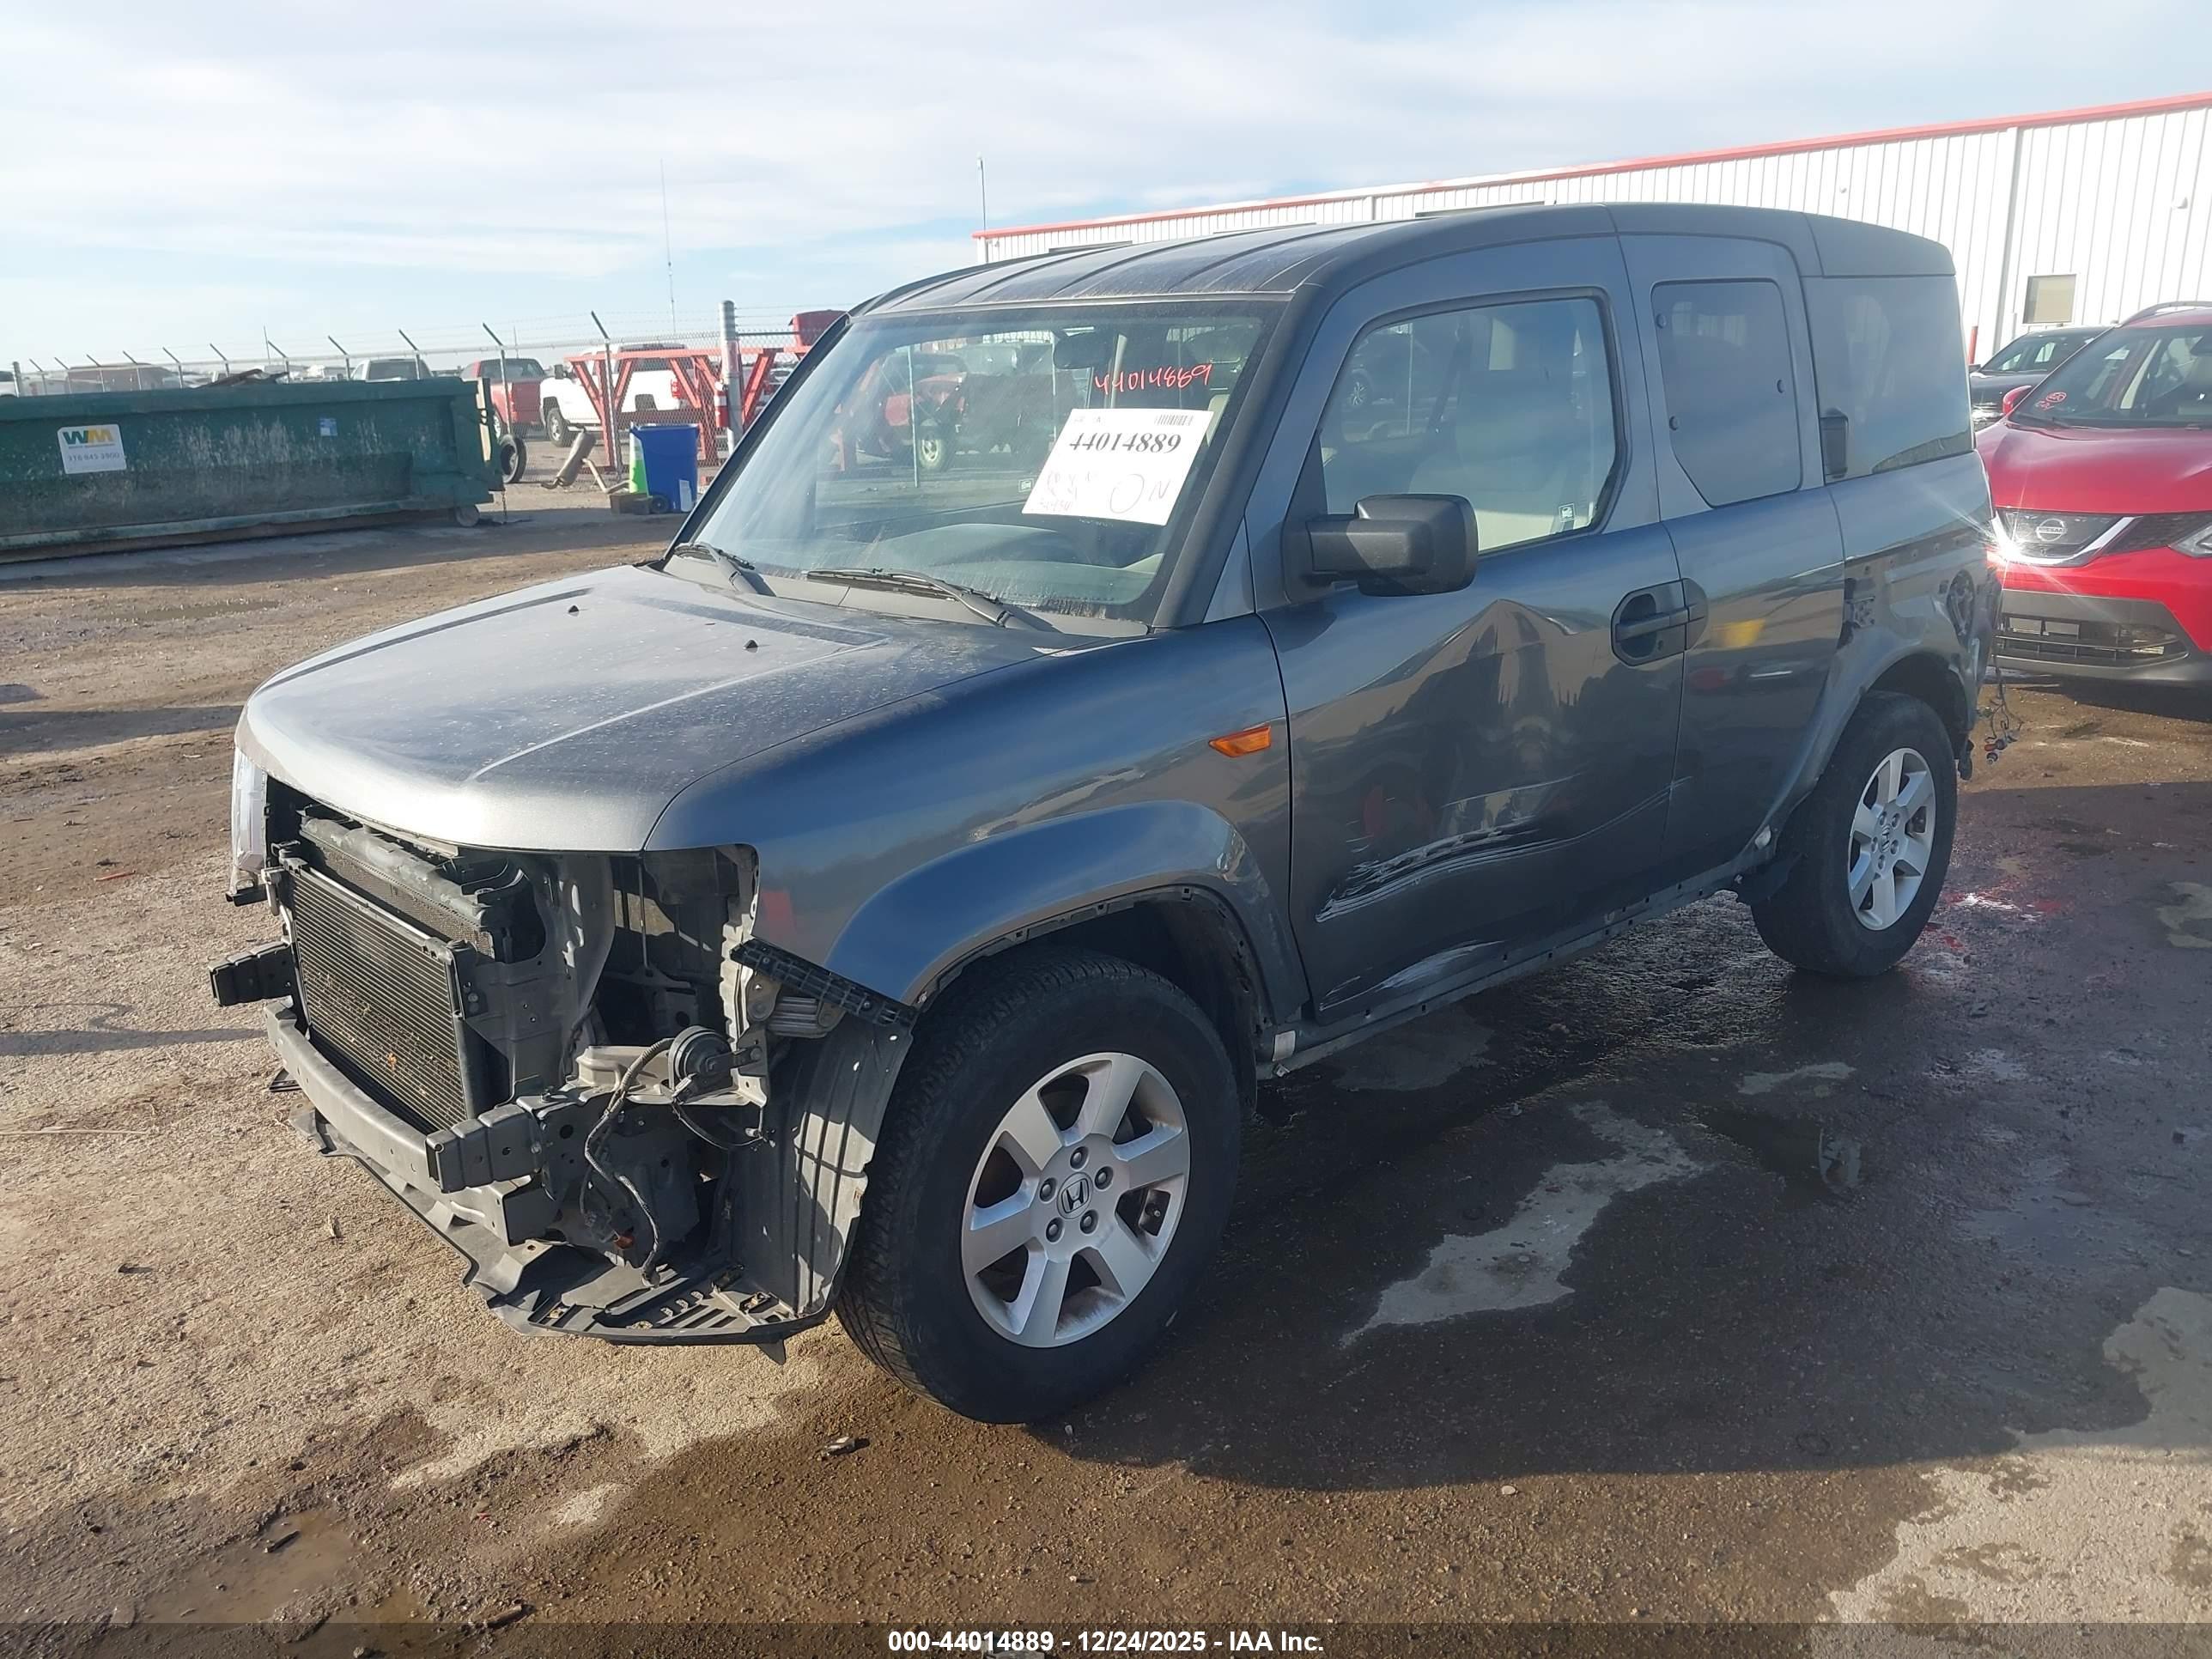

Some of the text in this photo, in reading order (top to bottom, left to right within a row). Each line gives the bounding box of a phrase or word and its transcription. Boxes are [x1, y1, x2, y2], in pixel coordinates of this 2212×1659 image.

[1094, 363, 1212, 395] 44014889
[62, 429, 114, 445] WM
[1069, 432, 1182, 453] 44014889
